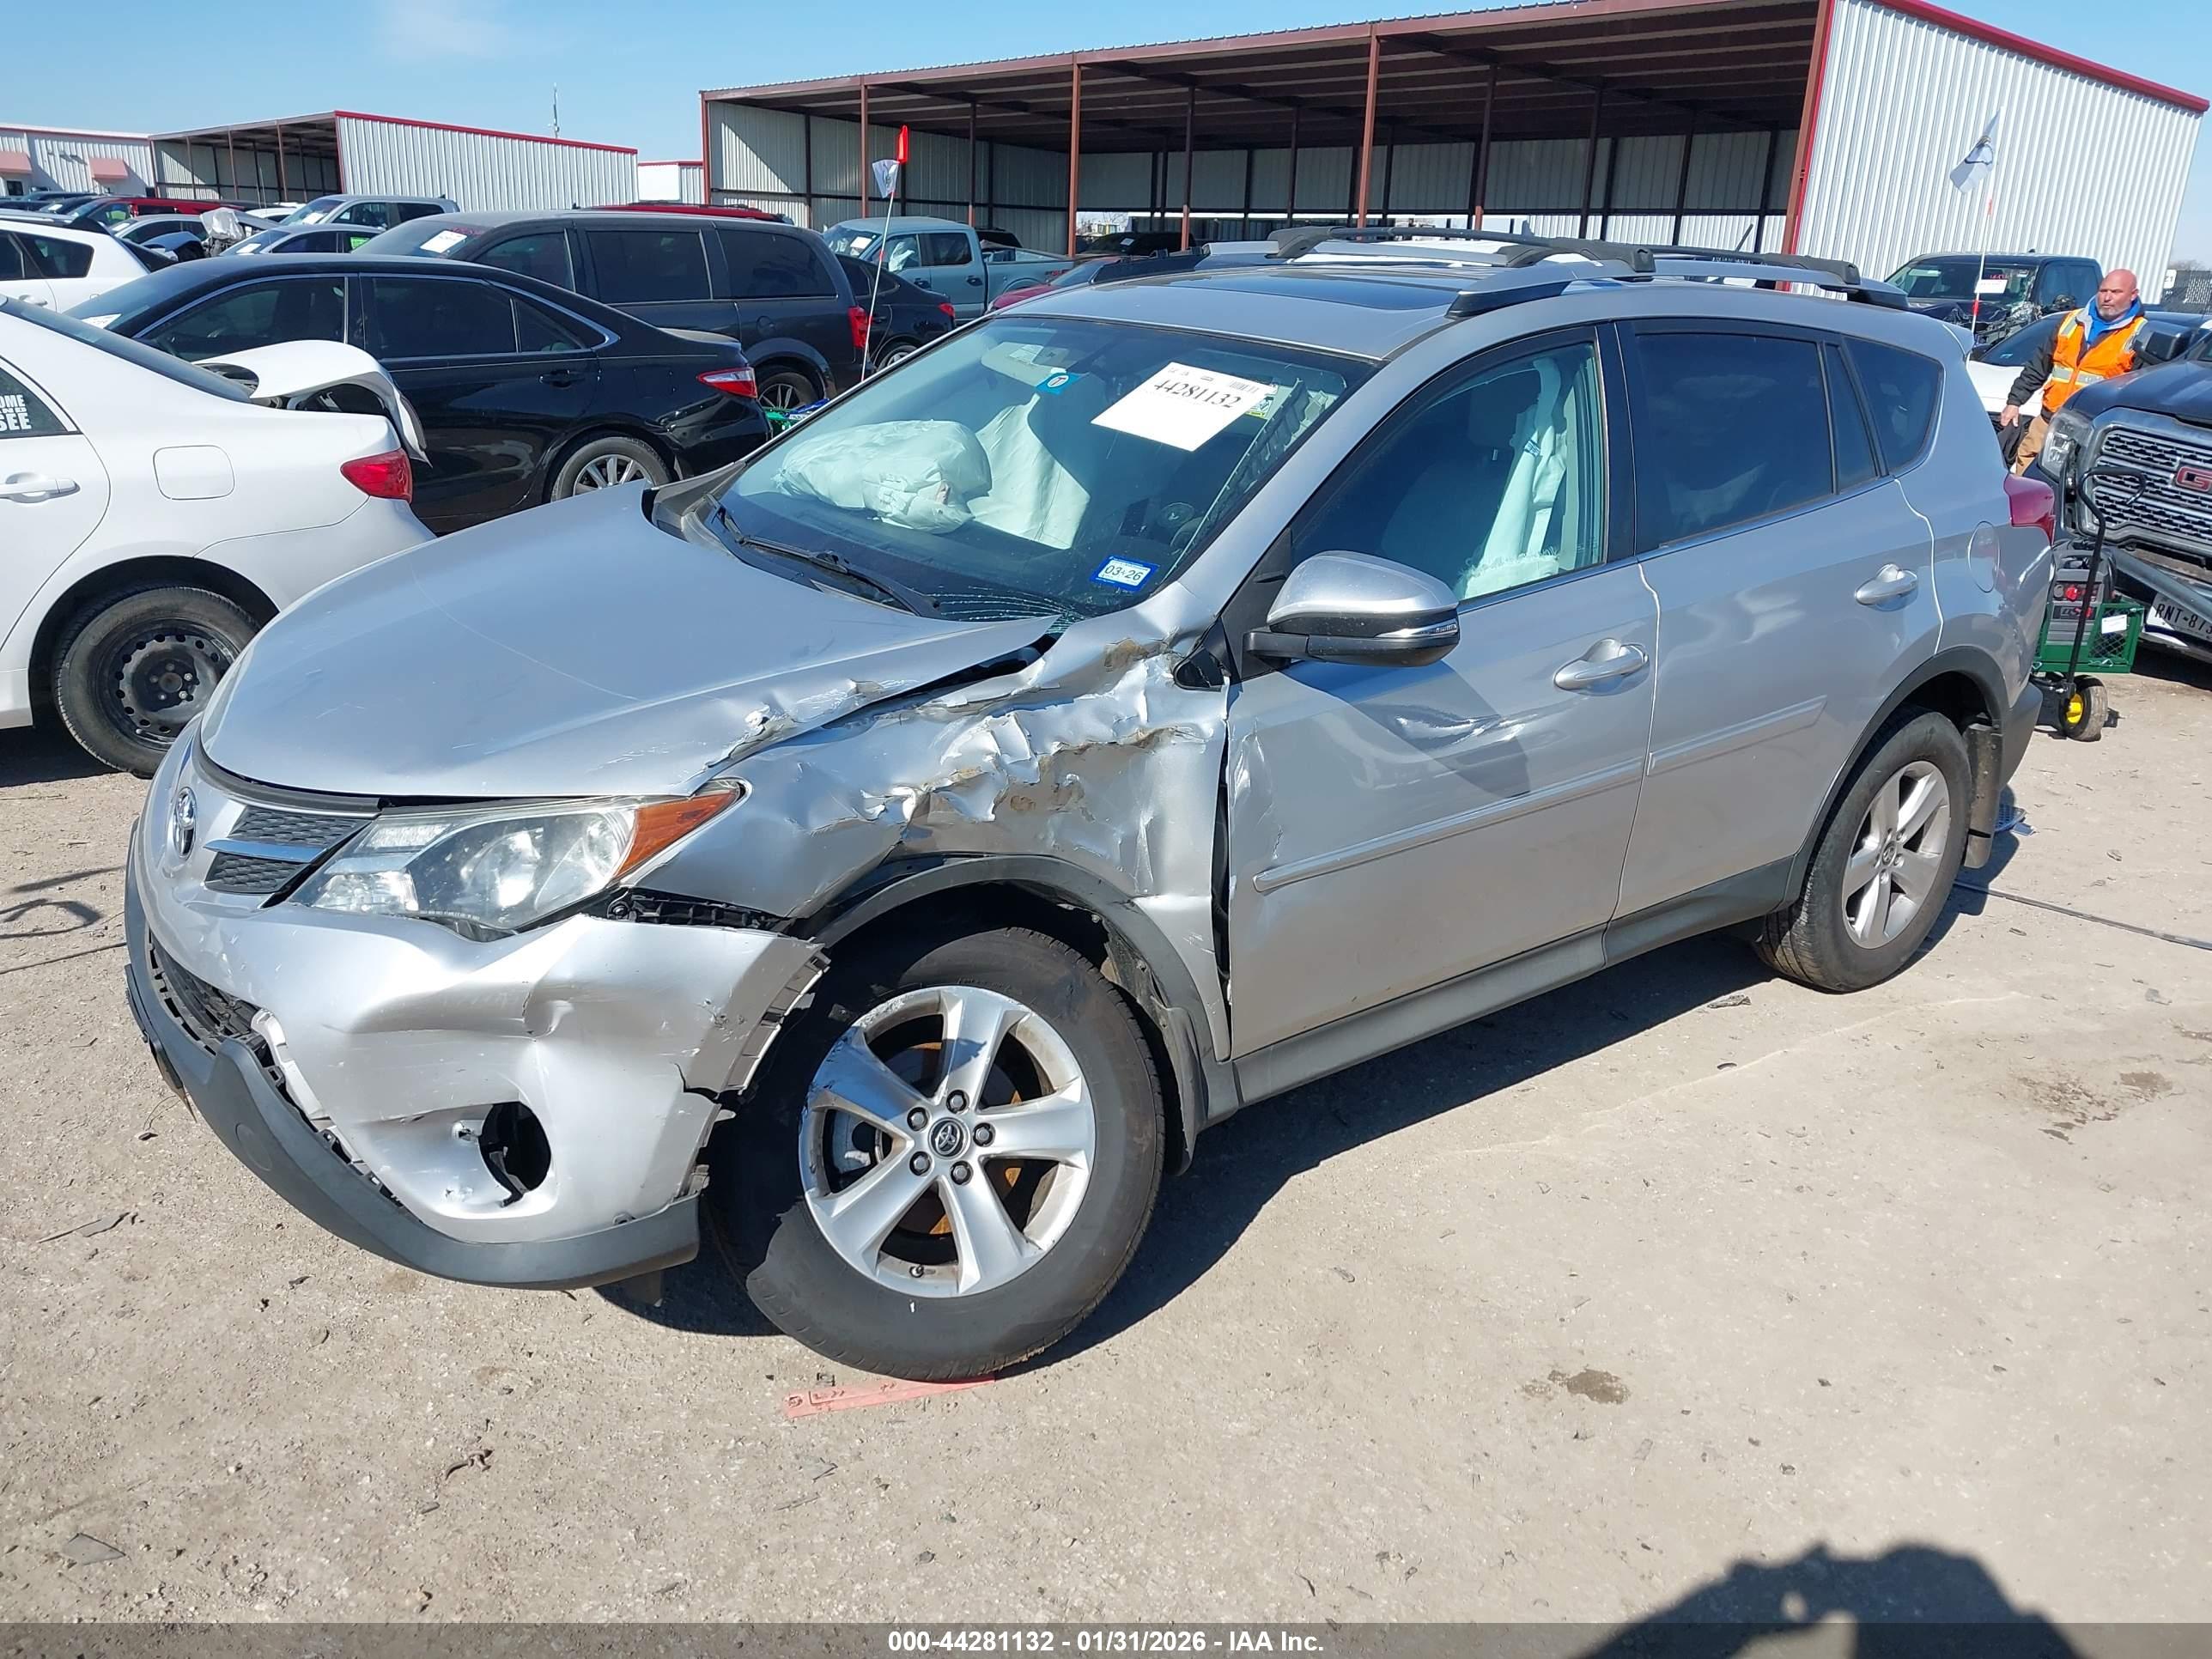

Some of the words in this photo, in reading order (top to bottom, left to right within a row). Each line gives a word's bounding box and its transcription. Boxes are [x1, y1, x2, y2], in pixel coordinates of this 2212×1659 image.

[1153, 380, 1242, 408] 44281132
[0, 412, 33, 431] SEE
[1104, 564, 1123, 576] 03
[1124, 569, 1144, 581] 26
